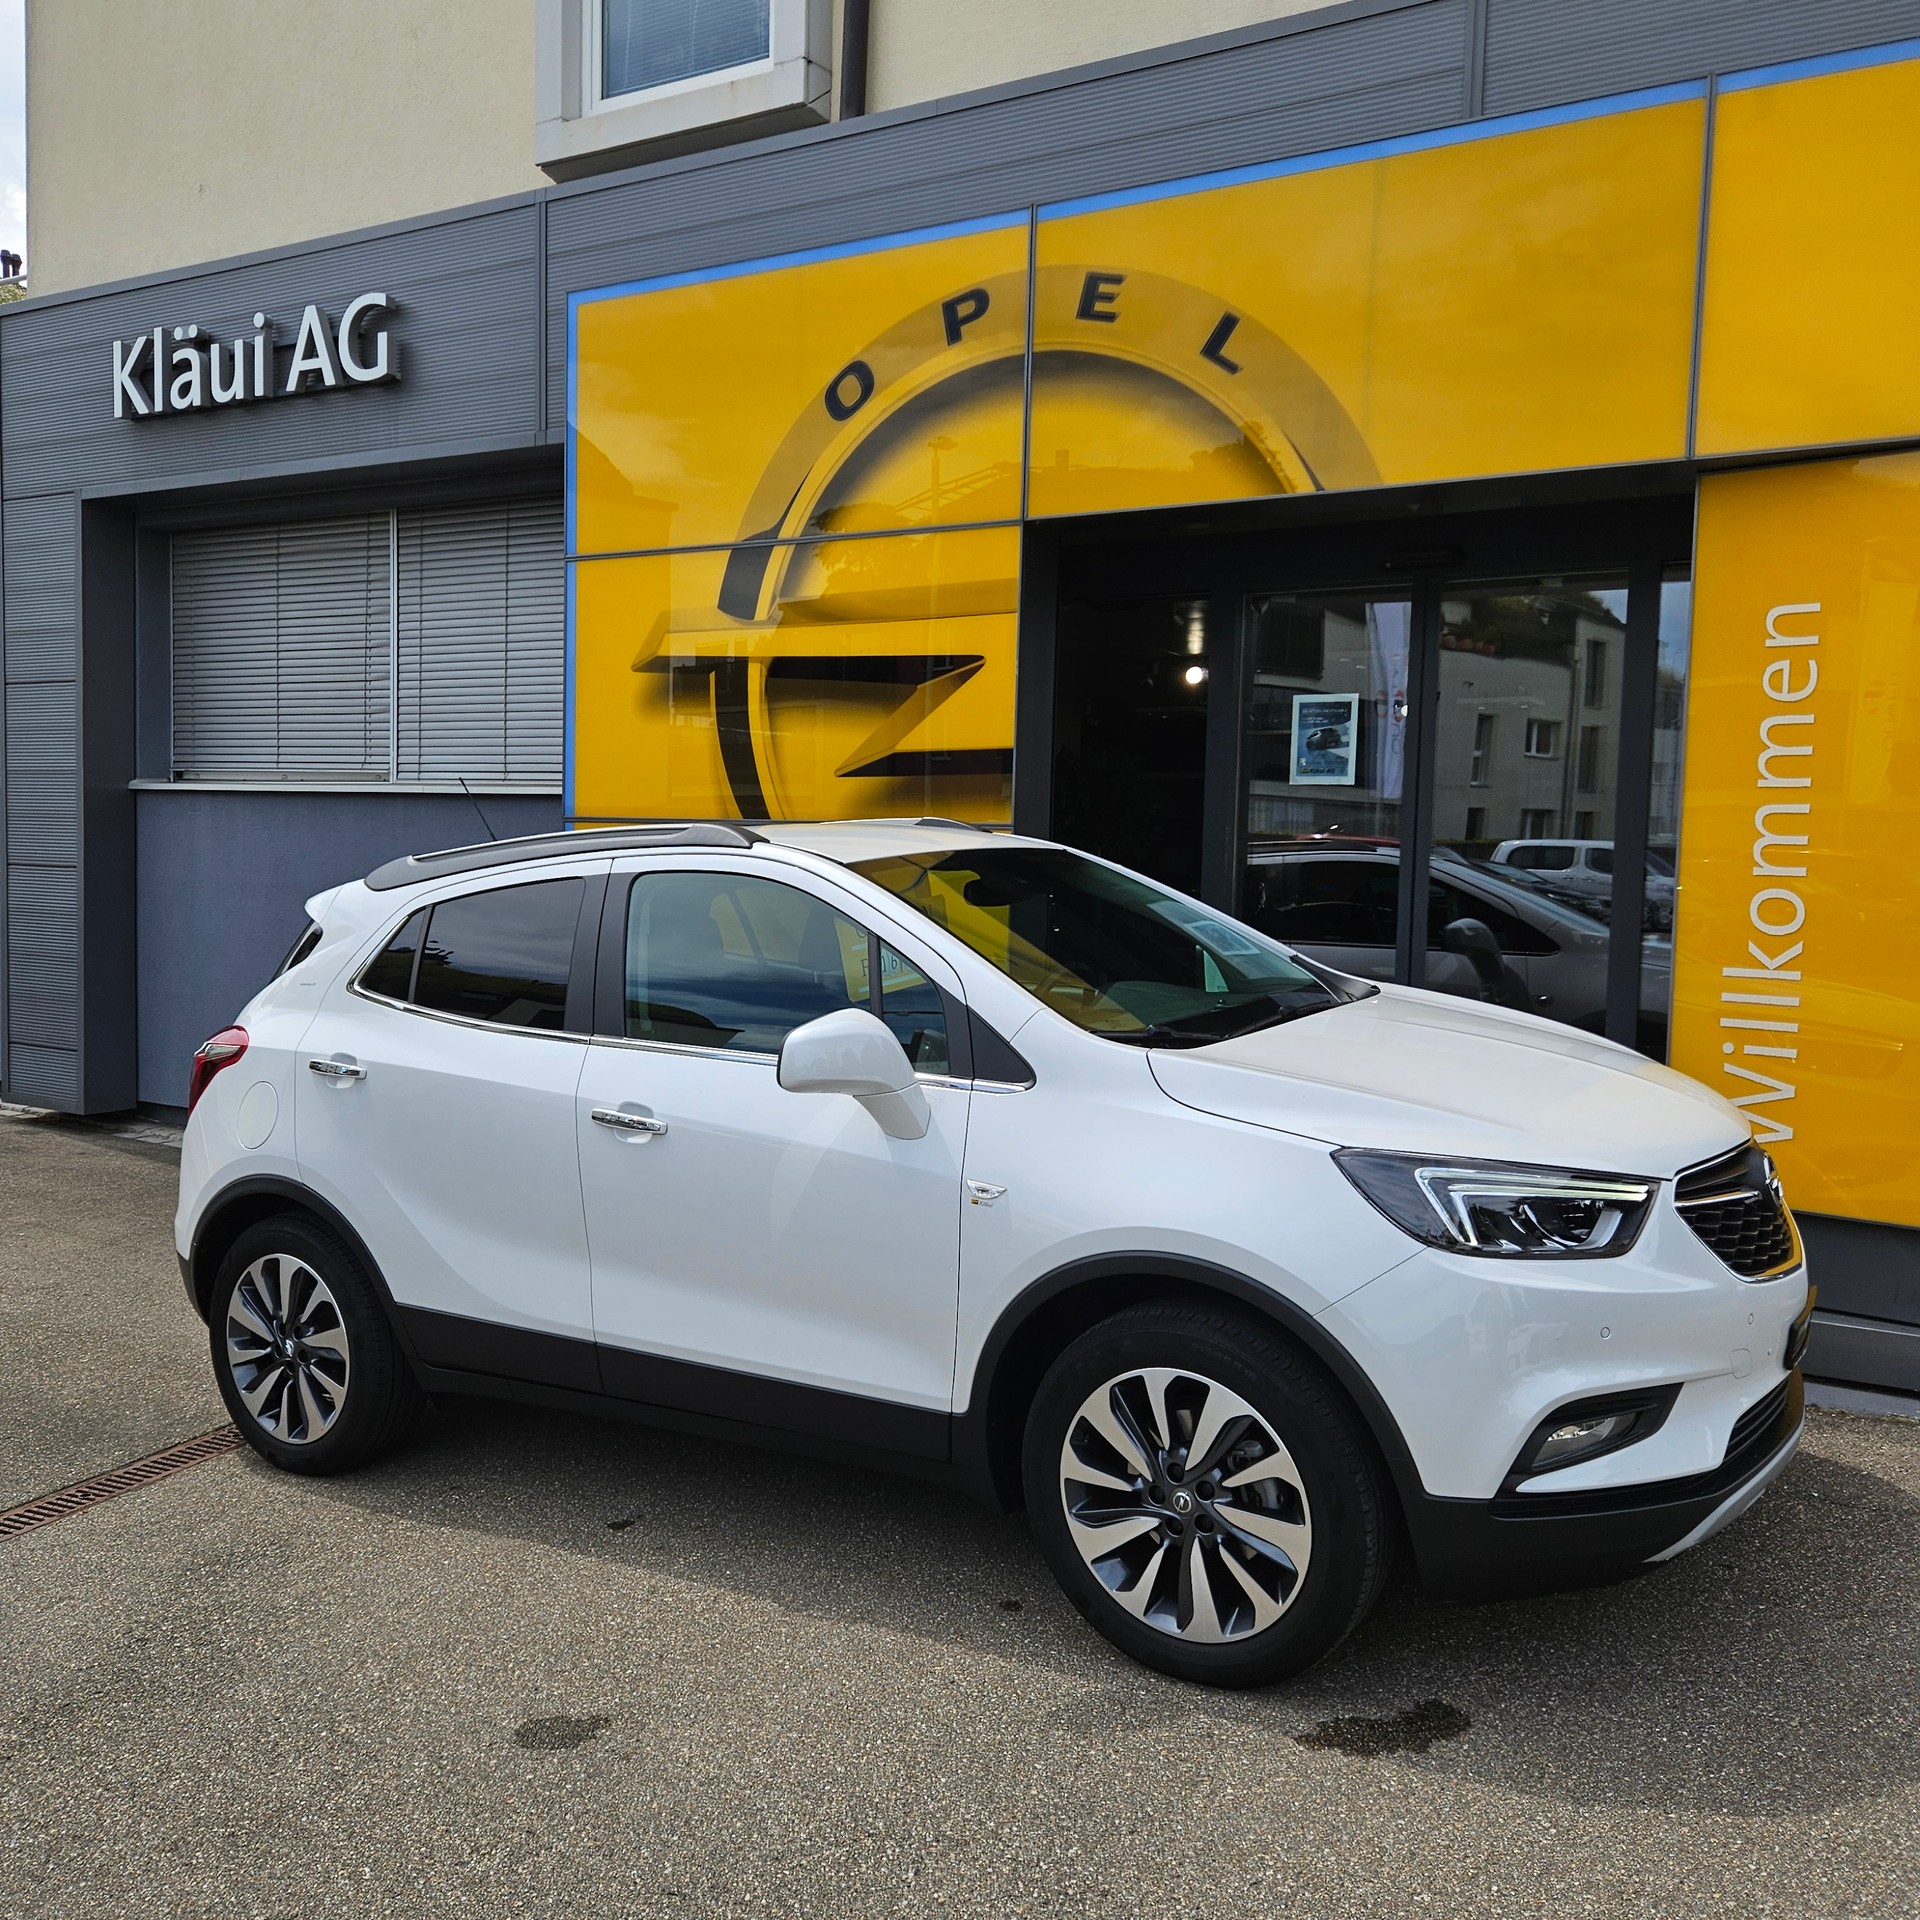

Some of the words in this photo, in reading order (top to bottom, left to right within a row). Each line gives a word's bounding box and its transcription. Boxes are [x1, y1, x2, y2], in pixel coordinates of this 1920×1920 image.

[112, 311, 270, 419] Kläui
[285, 292, 397, 394] AG
[824, 271, 1244, 422] OPEL
[1719, 601, 1821, 1144] Willkommen
